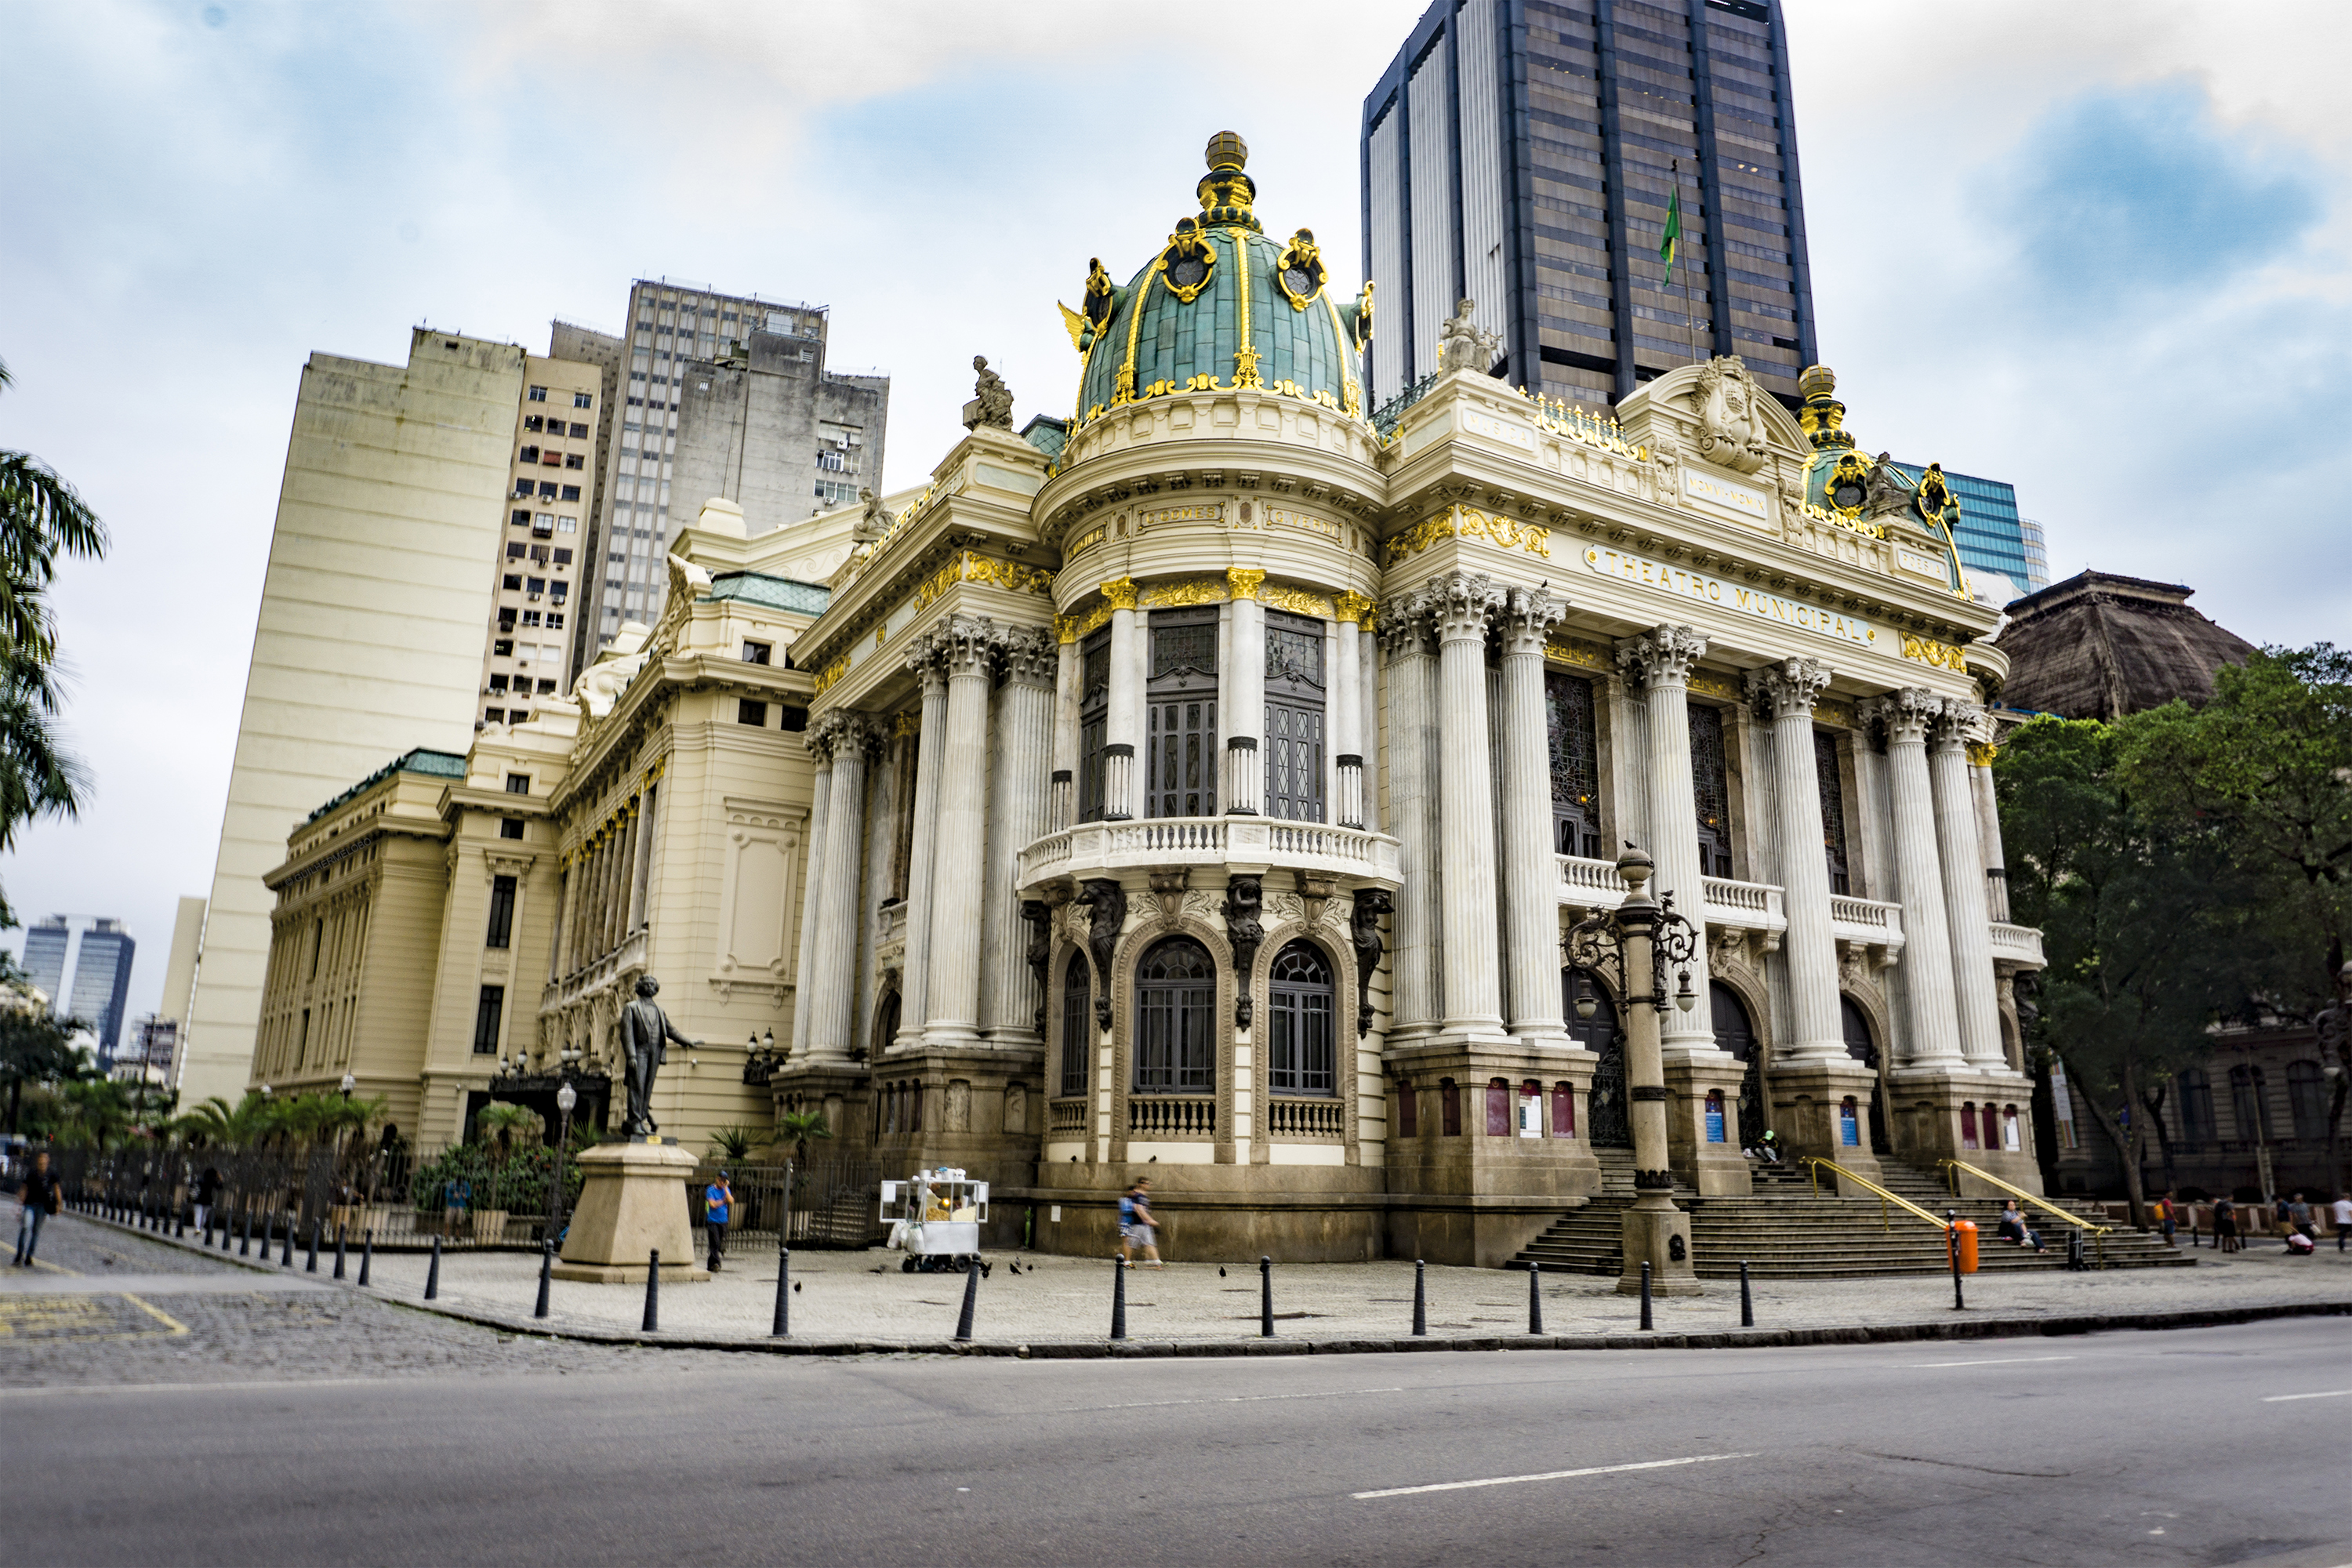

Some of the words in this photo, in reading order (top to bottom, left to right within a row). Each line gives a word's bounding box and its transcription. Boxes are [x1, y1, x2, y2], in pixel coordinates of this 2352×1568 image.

[1470, 414, 1528, 445] MUSICA
[1903, 553, 1942, 577] POESIA
[1605, 550, 1721, 601] THEATRO
[1735, 587, 1861, 641] MUNICIPAL
